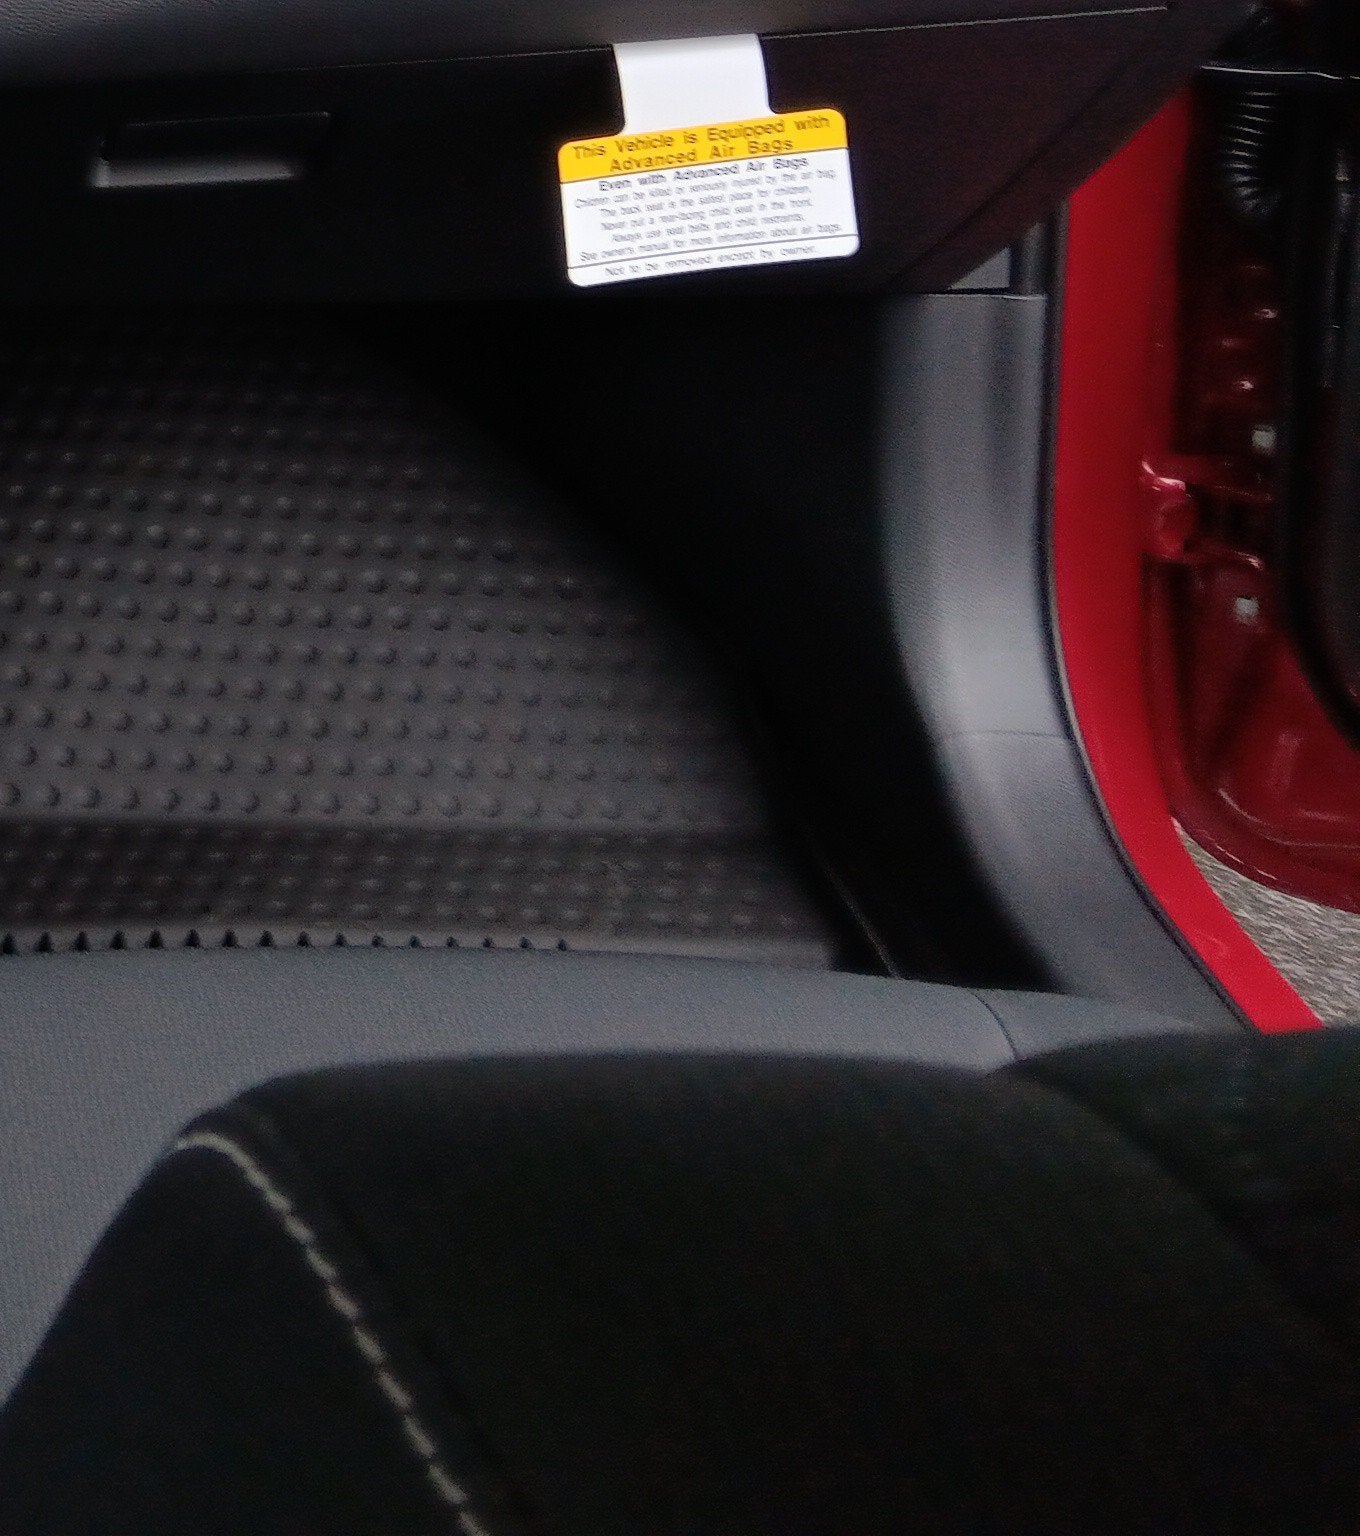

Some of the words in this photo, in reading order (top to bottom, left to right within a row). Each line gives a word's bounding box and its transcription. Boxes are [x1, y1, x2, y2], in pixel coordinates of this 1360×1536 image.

[573, 142, 605, 158] This
[614, 133, 672, 153] Vehicle
[683, 130, 697, 145] is
[707, 119, 784, 144] Equipped
[793, 113, 829, 131] with
[610, 149, 697, 171] Advanced
[711, 143, 733, 158] Air
[748, 136, 792, 155] Bags
[599, 177, 630, 191] Even
[637, 173, 666, 186] with
[673, 163, 738, 180] Advanced
[747, 160, 765, 172] Air
[773, 154, 808, 171] Bags
